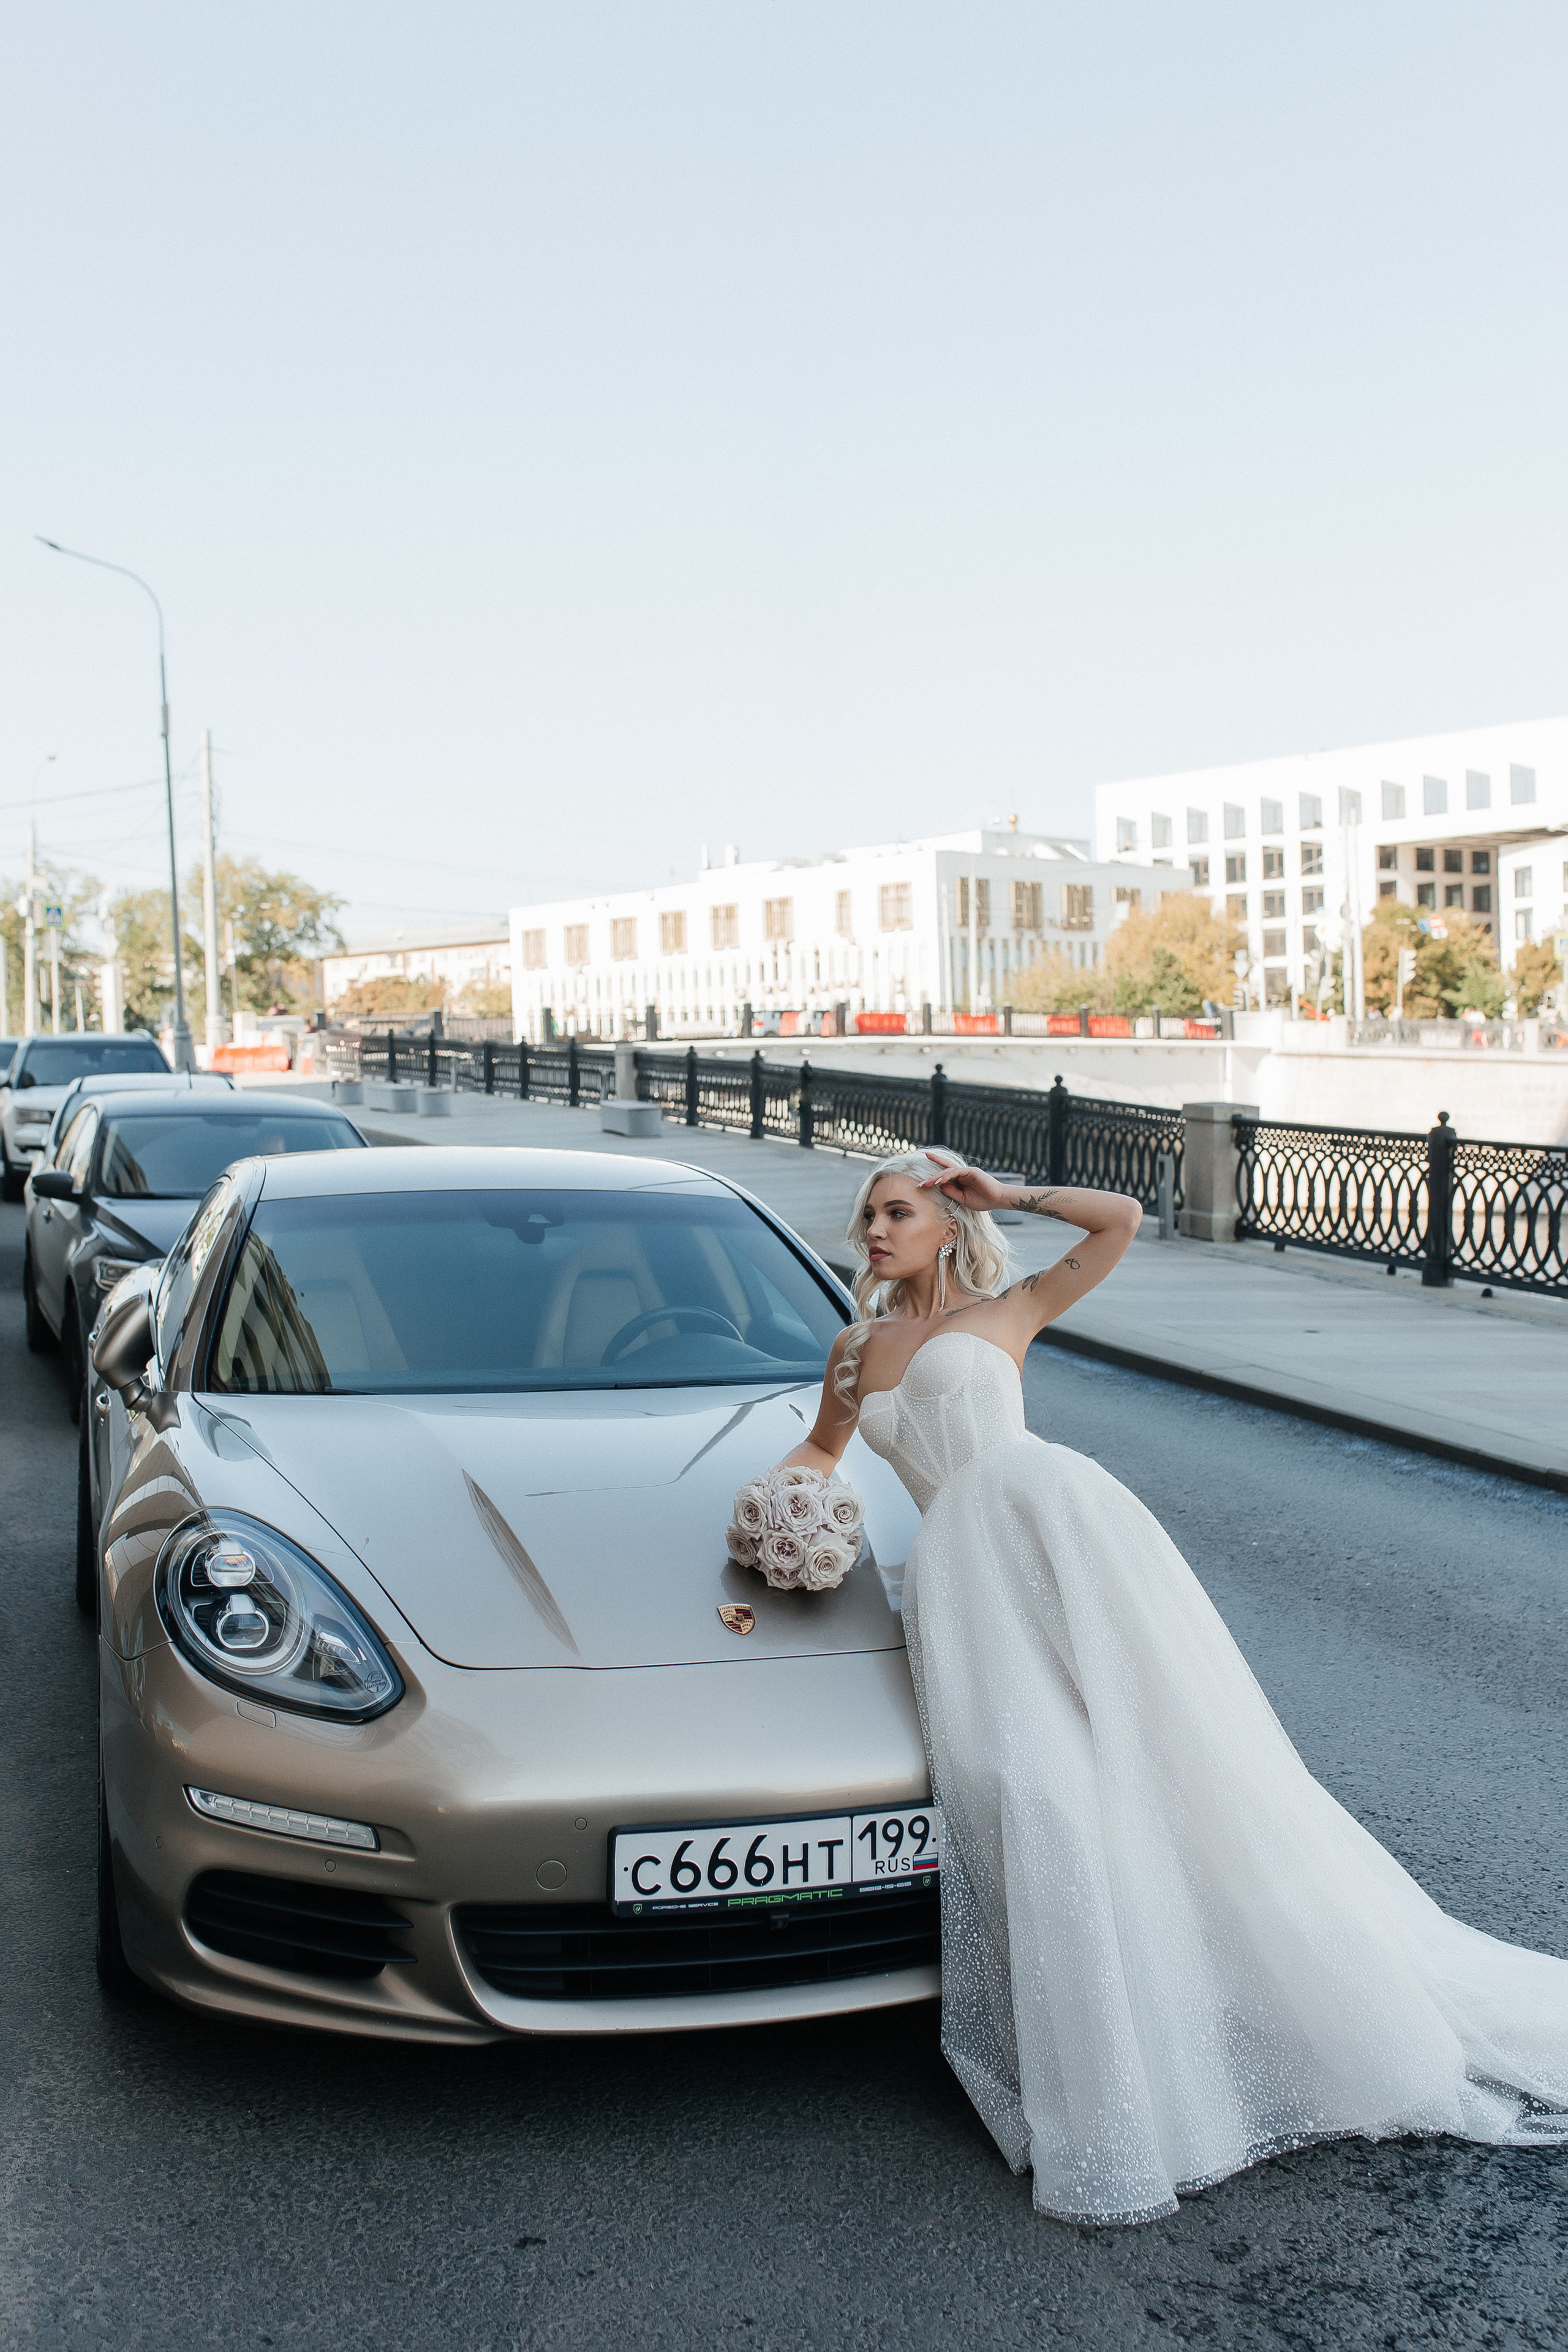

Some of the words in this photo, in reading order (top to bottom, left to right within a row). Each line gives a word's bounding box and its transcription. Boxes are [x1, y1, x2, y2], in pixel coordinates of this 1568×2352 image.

[857, 1814, 931, 1861] 199
[875, 1856, 911, 1875] RUS
[727, 1888, 843, 1907] PRAGMATIC
